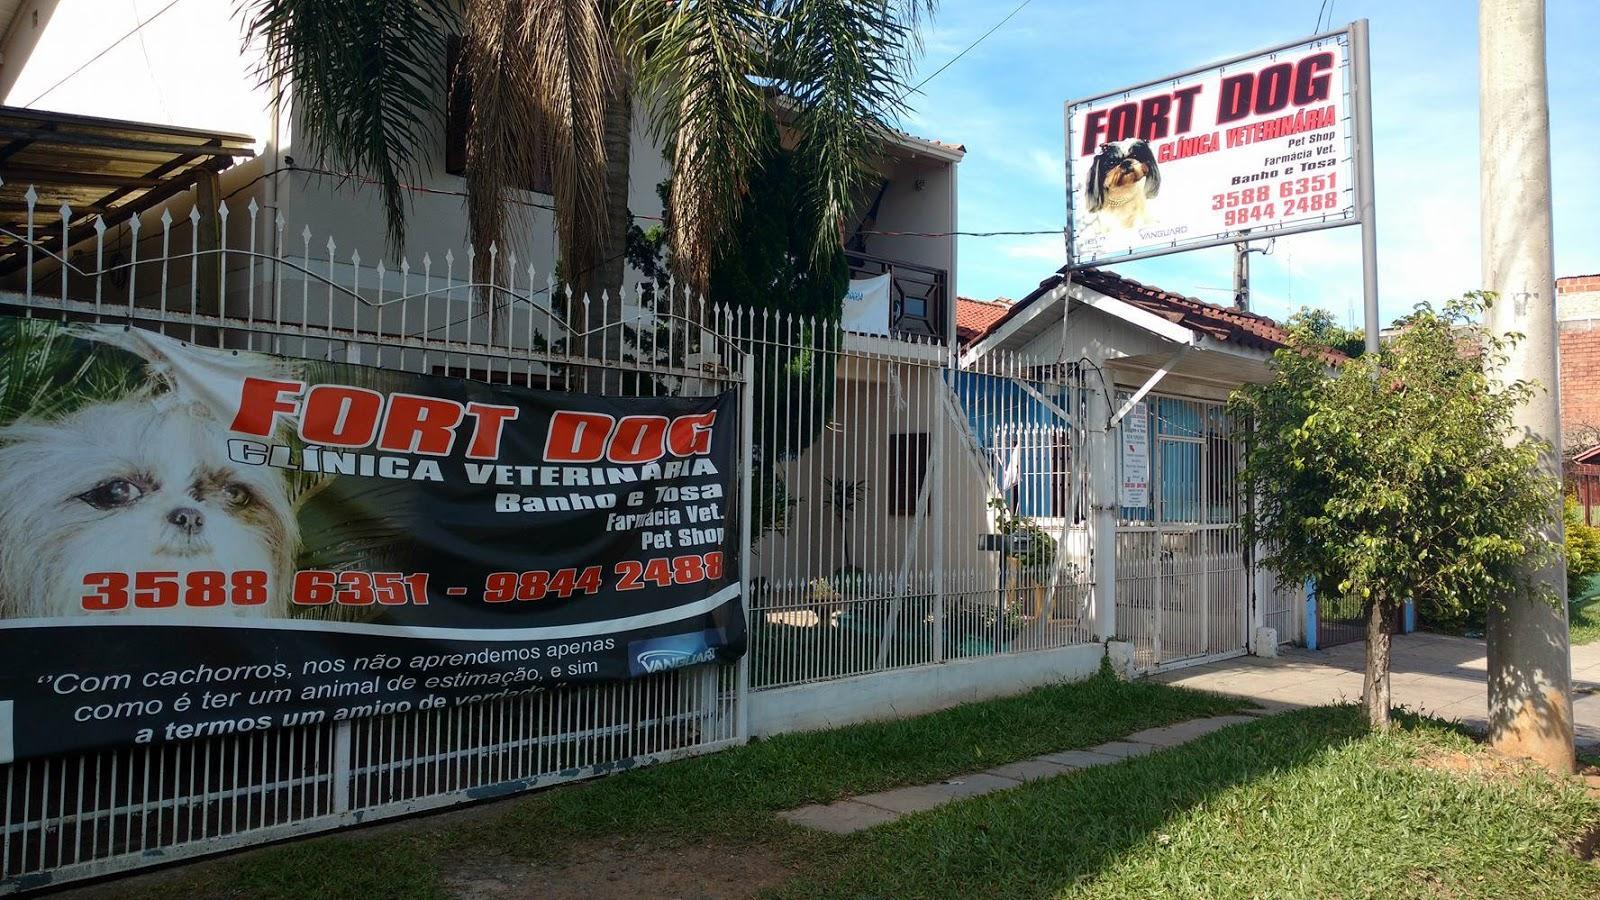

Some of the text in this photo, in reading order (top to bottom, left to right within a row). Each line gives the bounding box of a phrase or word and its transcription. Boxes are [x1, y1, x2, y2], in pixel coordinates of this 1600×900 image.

[1081, 50, 1336, 157] FORT DOG
[1157, 105, 1336, 163] CLÍNICA VETERINÁRIA
[1264, 144, 1337, 167] Farmácia Vet.
[1287, 131, 1336, 149] Pet Shop
[1212, 171, 1337, 211] 3588 6351
[1231, 158, 1337, 186] Banho e Tosa
[1224, 191, 1338, 227] 9844 2488
[229, 376, 718, 464] FORT DOG
[227, 438, 719, 487] CLÍNICA VETERINÁRIA
[495, 483, 724, 514] Banho e Tosa
[606, 502, 725, 532] Farmácia Vet.
[641, 531, 673, 550] Pet
[80, 570, 268, 612] 3588
[292, 570, 430, 606] 6351
[483, 565, 602, 604] 9844
[614, 551, 724, 592] 2488
[142, 663, 293, 688] cachorros,
[302, 657, 346, 676] nos
[353, 653, 401, 672] não
[409, 645, 541, 672] aprendemos
[546, 637, 616, 659] apenas
[74, 659, 599, 722] como é ter um animal de estimação, e sim
[134, 728, 154, 745] a
[165, 714, 273, 741] termos
[282, 709, 326, 728] um
[418, 694, 448, 711] de
